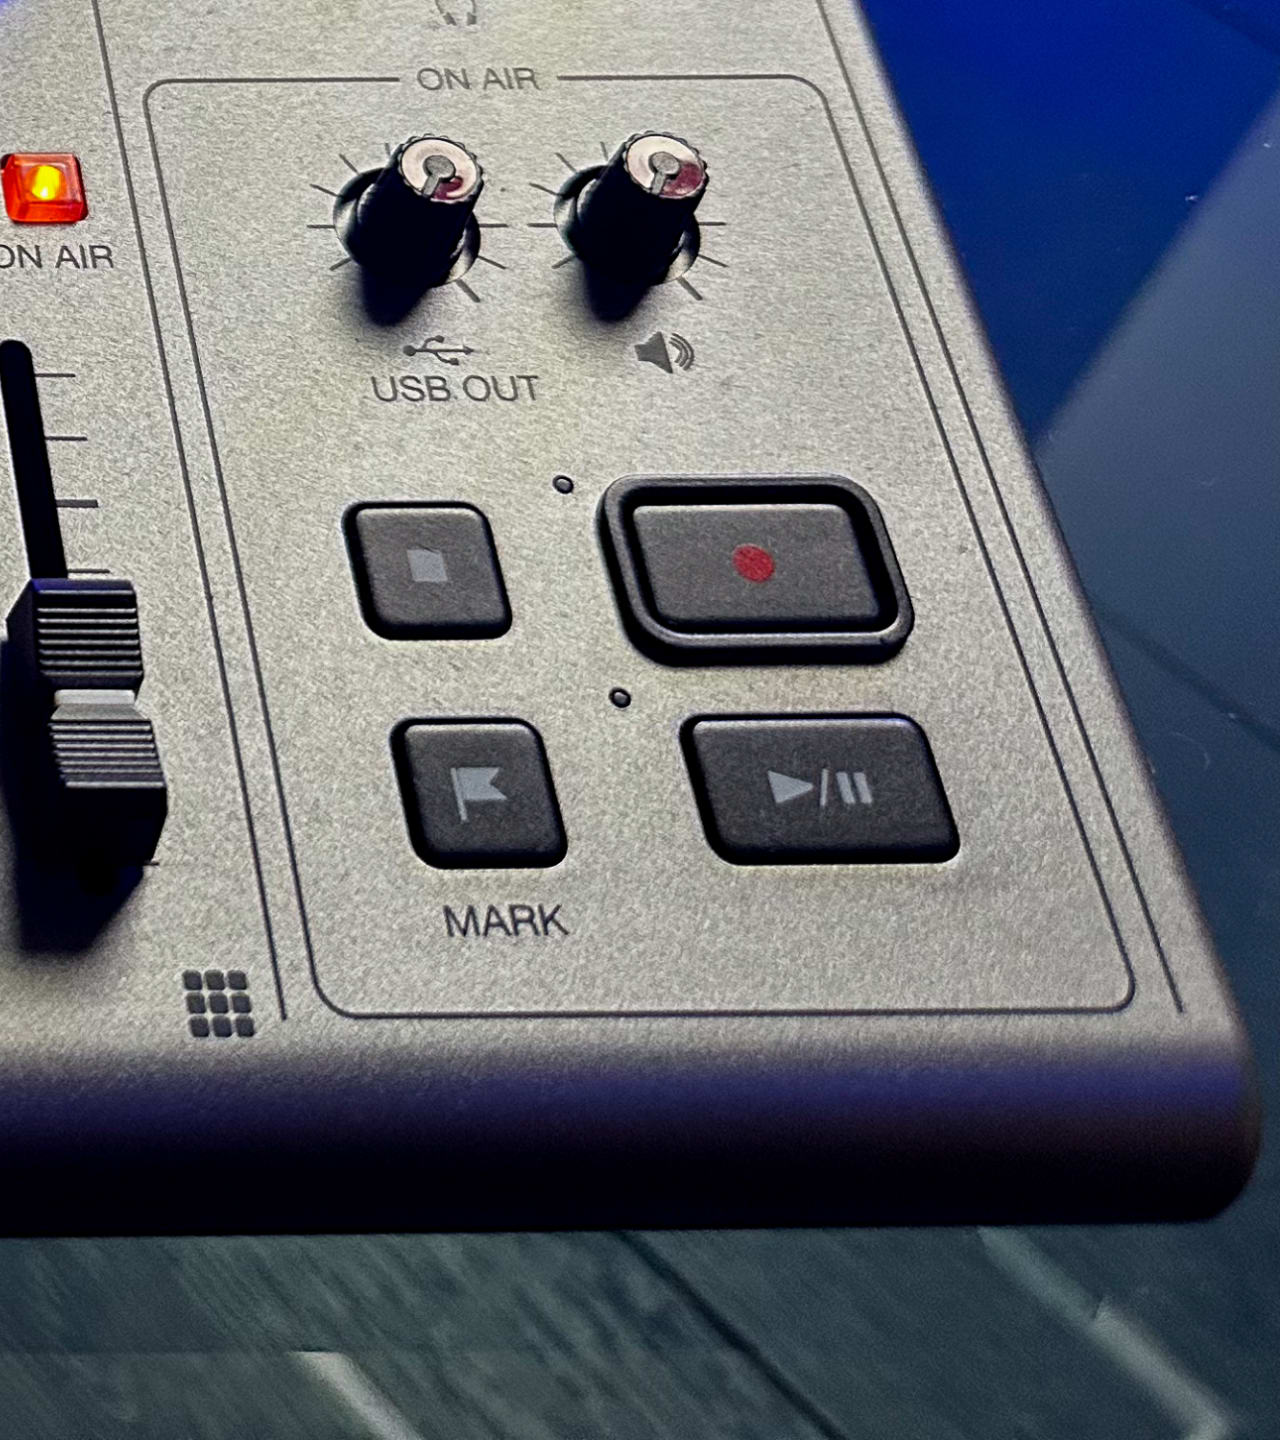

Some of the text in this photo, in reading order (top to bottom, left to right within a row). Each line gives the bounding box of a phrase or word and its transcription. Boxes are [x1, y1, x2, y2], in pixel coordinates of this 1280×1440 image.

[416, 66, 541, 91] ON AIR
[54, 243, 116, 269] AIR
[370, 374, 539, 402] USB OUT
[442, 903, 570, 938] MARK
